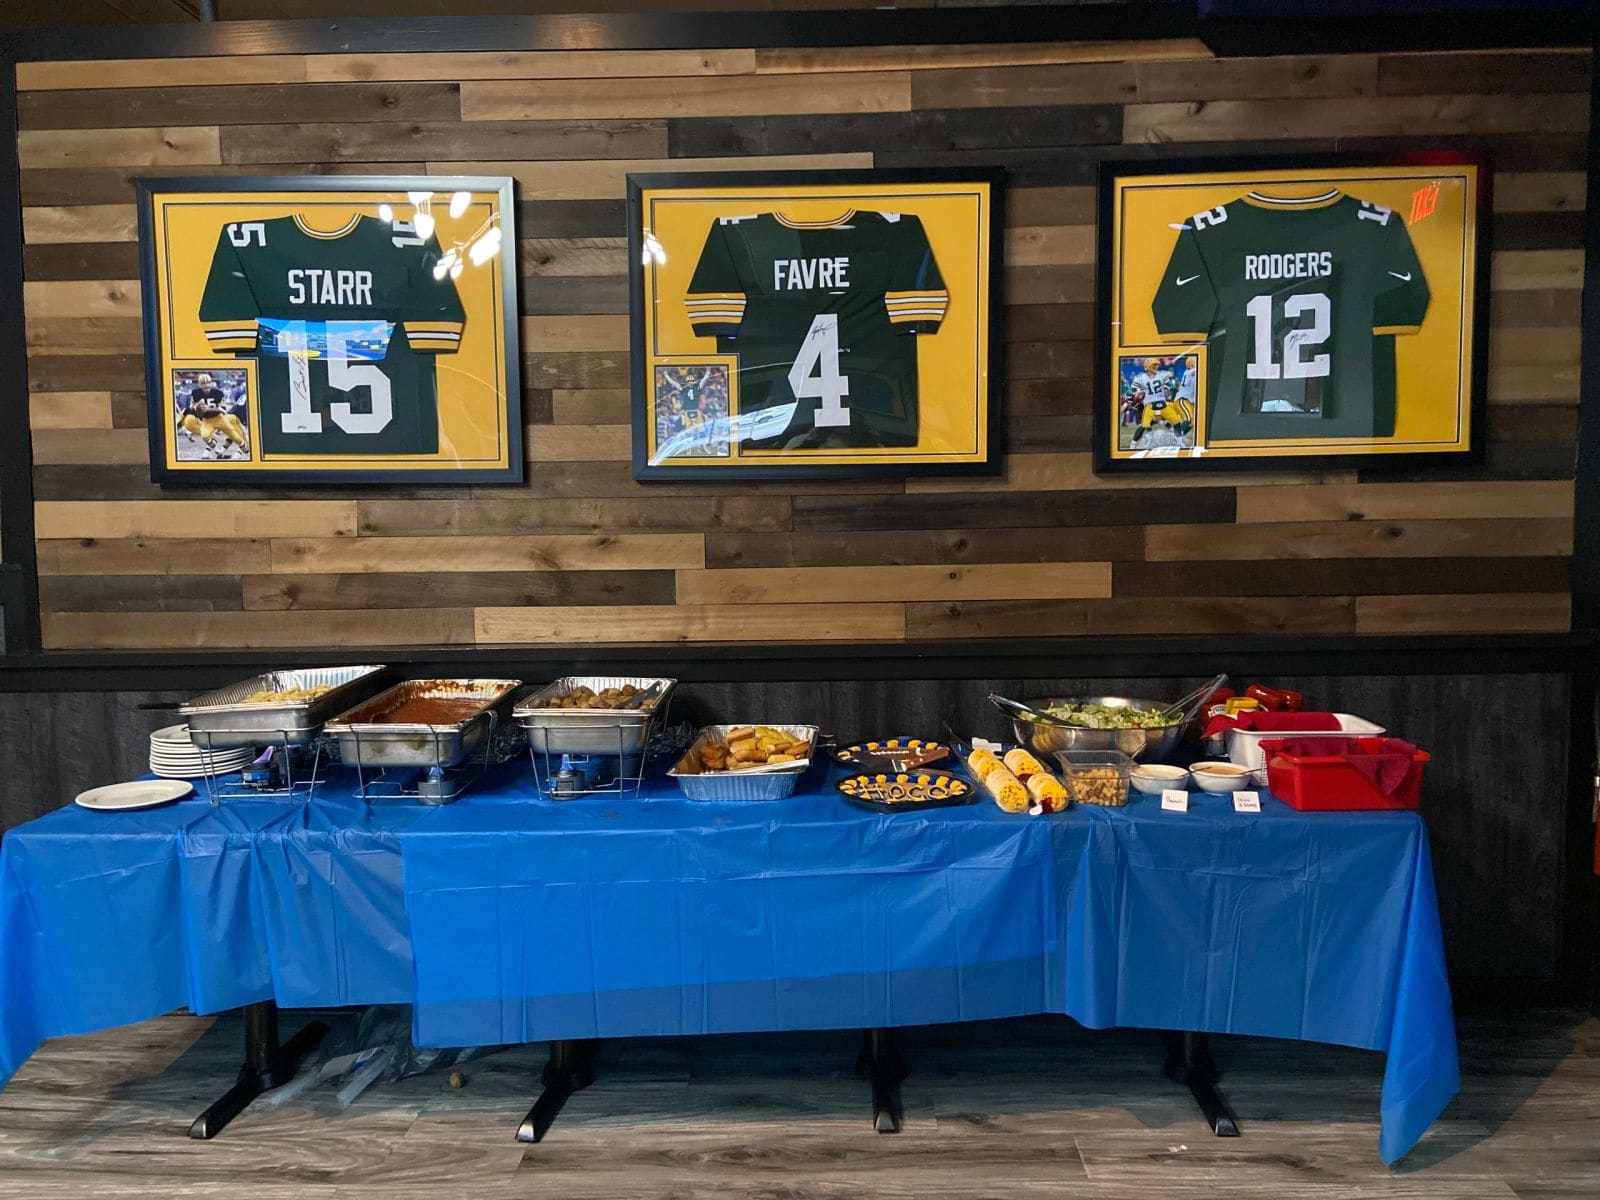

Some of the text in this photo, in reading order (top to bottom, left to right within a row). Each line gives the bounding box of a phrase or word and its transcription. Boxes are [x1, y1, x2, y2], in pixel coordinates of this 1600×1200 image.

[1193, 206, 1228, 231] 2
[227, 223, 266, 247] 5
[774, 257, 850, 291] FAVRE
[1245, 251, 1332, 281] RODGERS
[288, 268, 373, 306] STARR
[1246, 292, 1331, 380] 12
[278, 320, 393, 434] 15
[788, 313, 851, 428] 4
[687, 389, 695, 401] 4
[1145, 379, 1162, 396] 12
